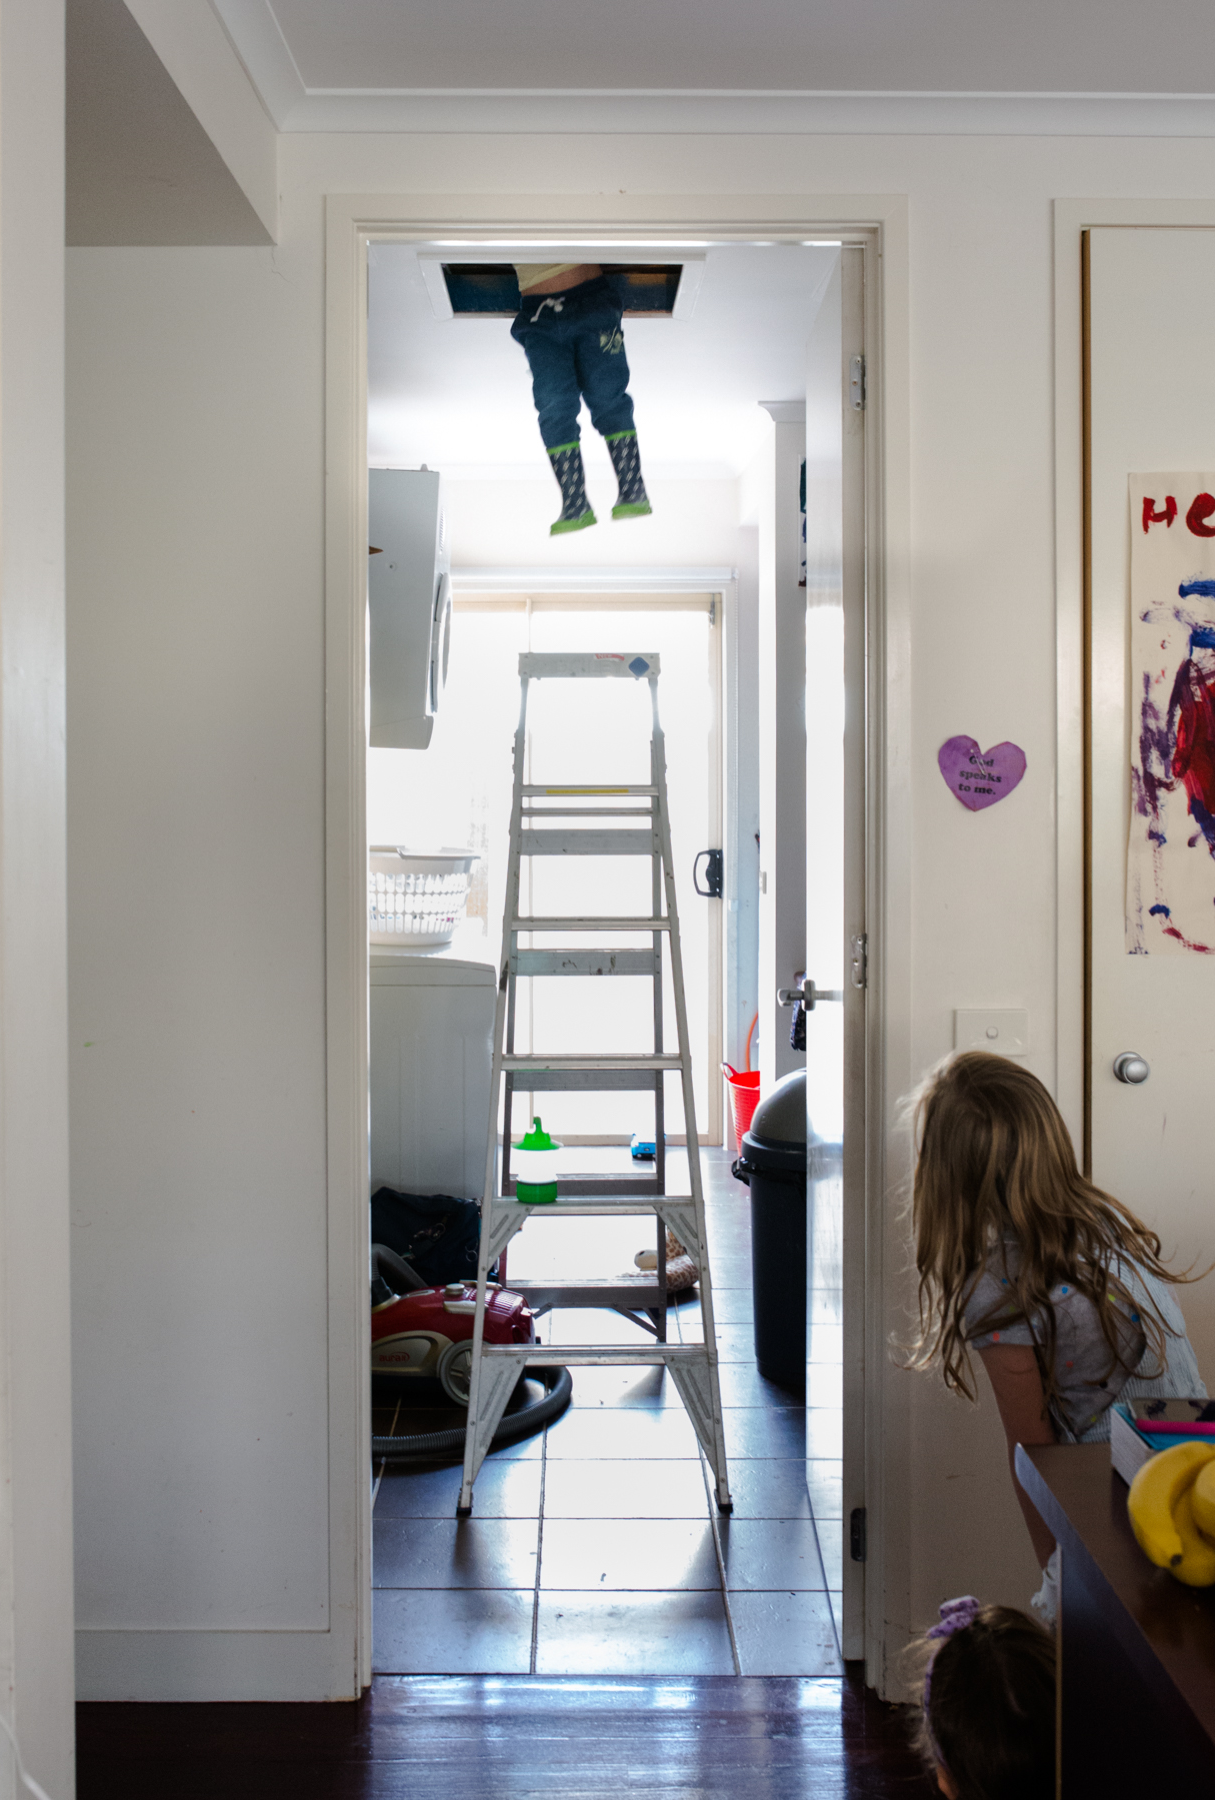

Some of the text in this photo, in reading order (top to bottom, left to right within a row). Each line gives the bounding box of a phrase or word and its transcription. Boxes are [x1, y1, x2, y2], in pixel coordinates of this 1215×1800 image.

[969, 755, 995, 767] God
[959, 770, 1002, 783] speaks
[958, 783, 996, 795] to me.
